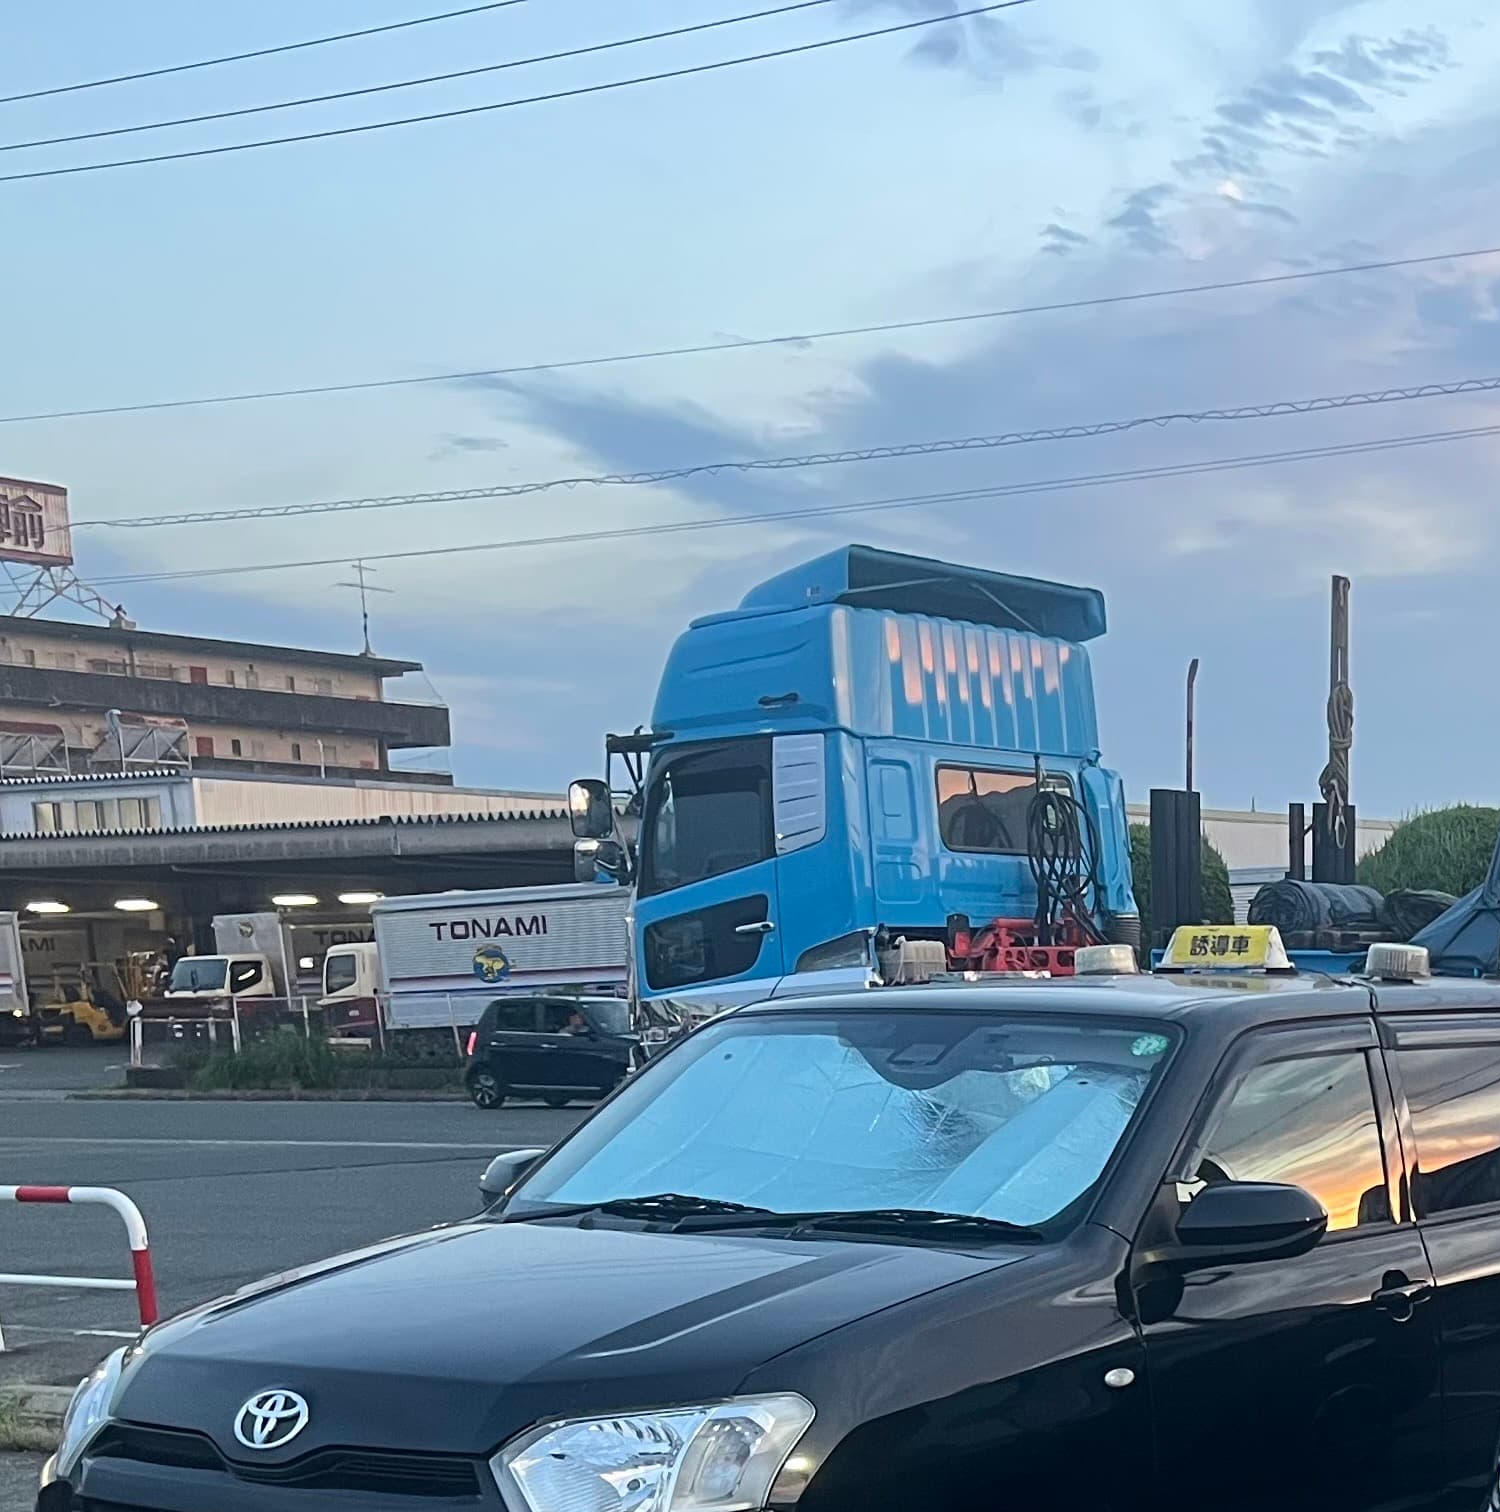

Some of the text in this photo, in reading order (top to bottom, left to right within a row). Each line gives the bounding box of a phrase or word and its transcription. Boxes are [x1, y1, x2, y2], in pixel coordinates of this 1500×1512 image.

[429, 915, 548, 941] TONAMI
[1190, 934, 1251, 956] 誘導車
